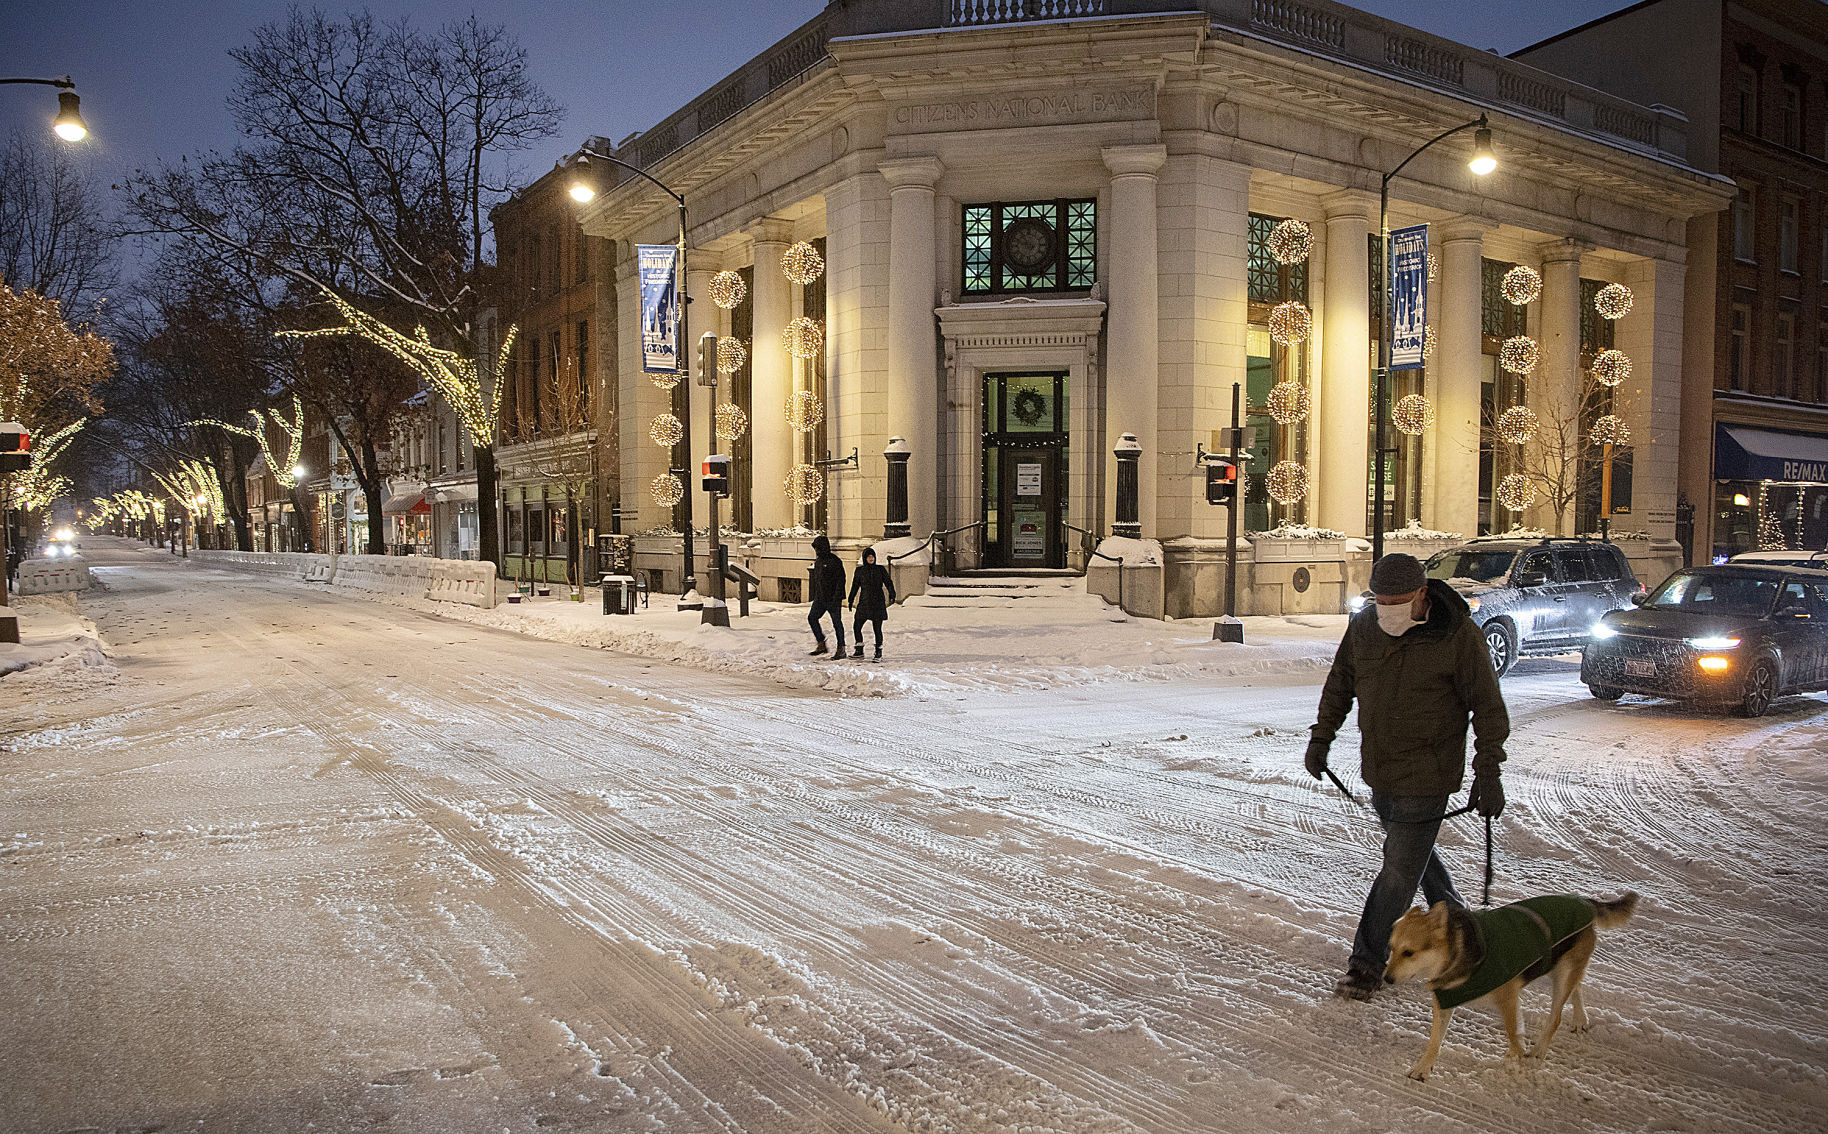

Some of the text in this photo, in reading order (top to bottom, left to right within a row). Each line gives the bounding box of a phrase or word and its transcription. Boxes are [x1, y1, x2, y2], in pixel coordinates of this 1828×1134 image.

[896, 90, 1150, 125] CITIZENS NATIONAL BANK
[1784, 461, 1826, 480] RE/MAX
